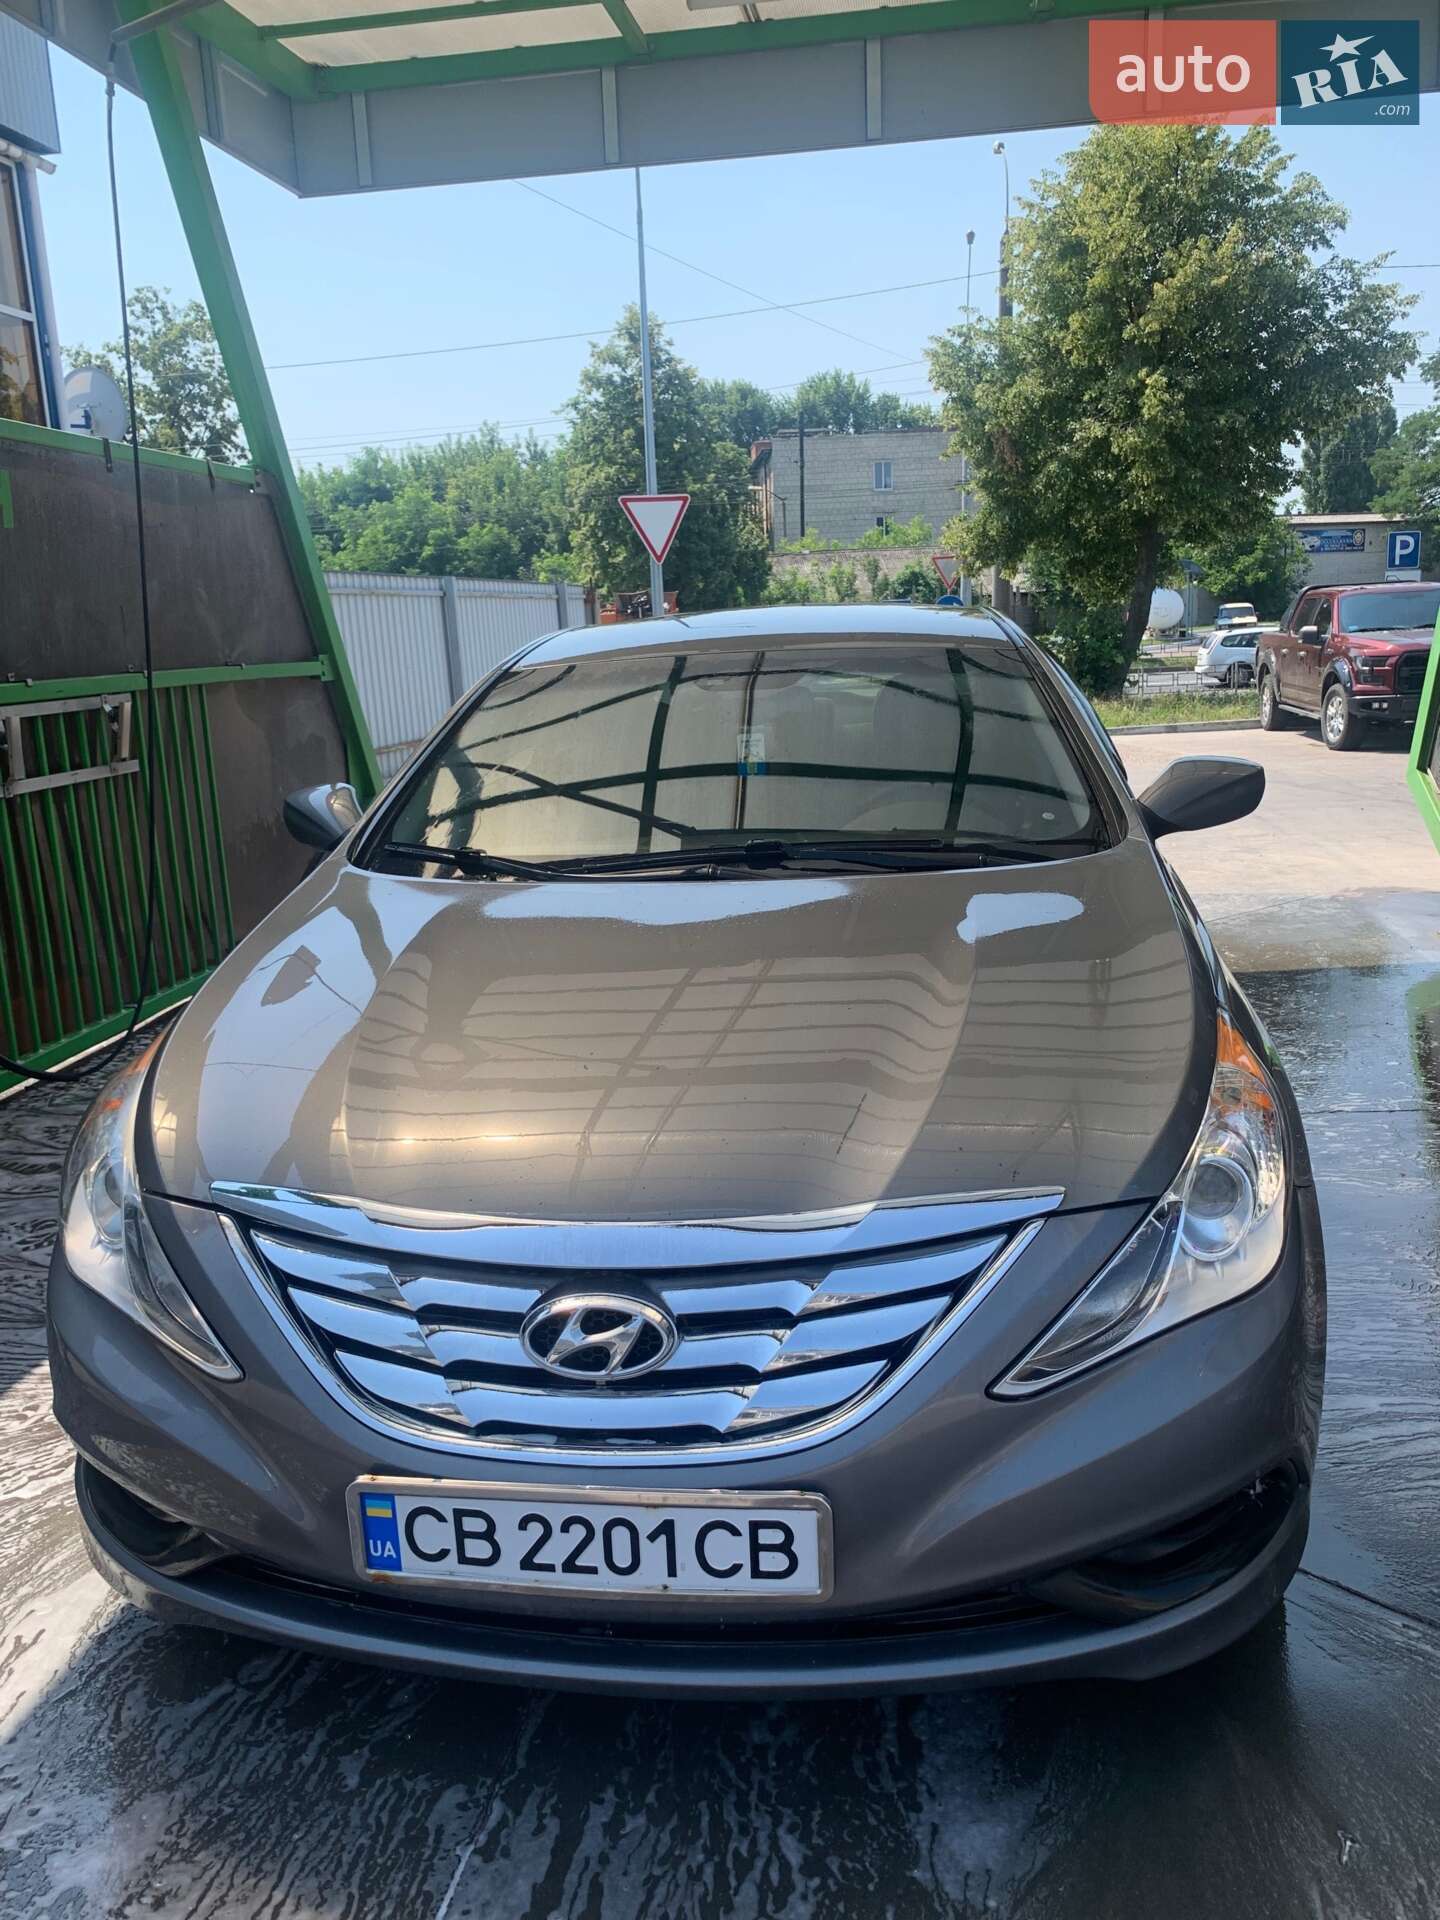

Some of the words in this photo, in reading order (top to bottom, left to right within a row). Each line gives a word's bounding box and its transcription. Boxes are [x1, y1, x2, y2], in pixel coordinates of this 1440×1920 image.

[1394, 535, 1415, 565] P
[369, 1538, 398, 1559] UA
[404, 1505, 502, 1568] CB
[517, 1512, 679, 1579] 2201
[694, 1519, 799, 1581] CB
